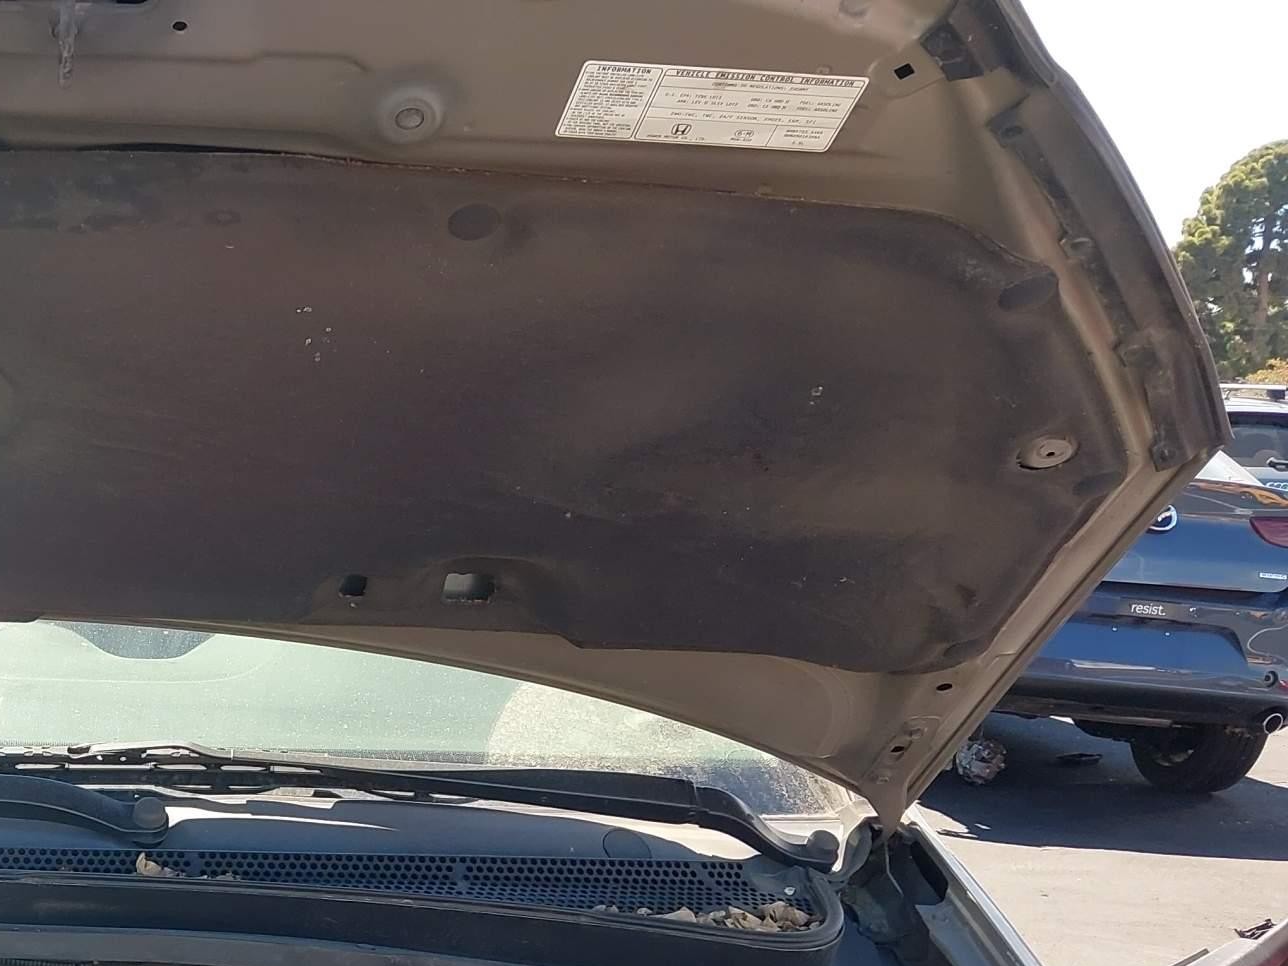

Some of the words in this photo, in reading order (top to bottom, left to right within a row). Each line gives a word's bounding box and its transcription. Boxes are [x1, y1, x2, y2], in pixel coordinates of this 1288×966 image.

[597, 66, 652, 74] INFORMATION
[676, 70, 710, 78] VEHICLE
[716, 71, 756, 80] EMISSION
[760, 73, 793, 83] CONTROL
[801, 77, 855, 87] INFORMATION
[1130, 603, 1166, 616] resist.
